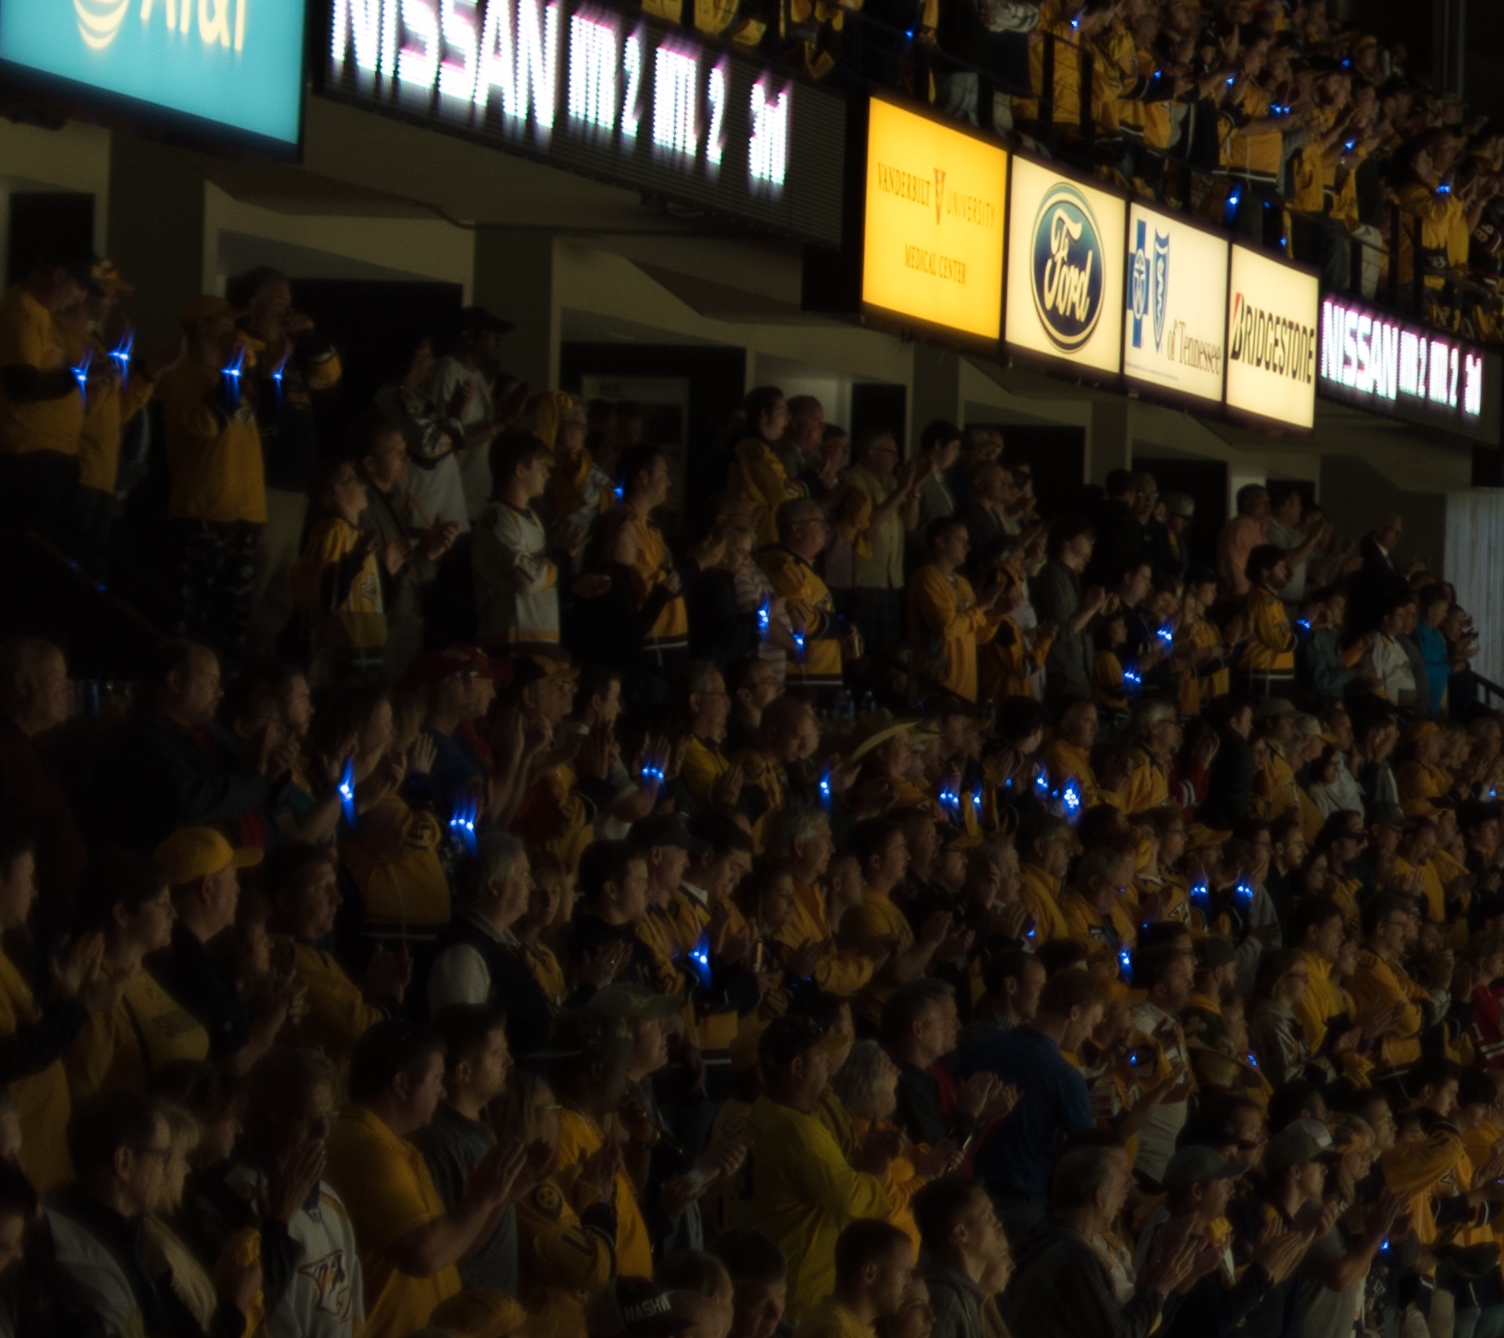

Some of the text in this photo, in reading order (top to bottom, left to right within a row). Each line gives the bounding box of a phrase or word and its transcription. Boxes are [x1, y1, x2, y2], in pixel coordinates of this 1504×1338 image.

[877, 162, 931, 207] VANDERBILT
[946, 189, 996, 231] UNIVERSITY
[904, 245, 967, 285] MEDICAL CENTER
[1044, 207, 1093, 323] Ford
[1166, 319, 1222, 375] of Tennessee
[1230, 292, 1314, 384] BRIDGESTONE
[1321, 301, 1399, 400] NISSAN
